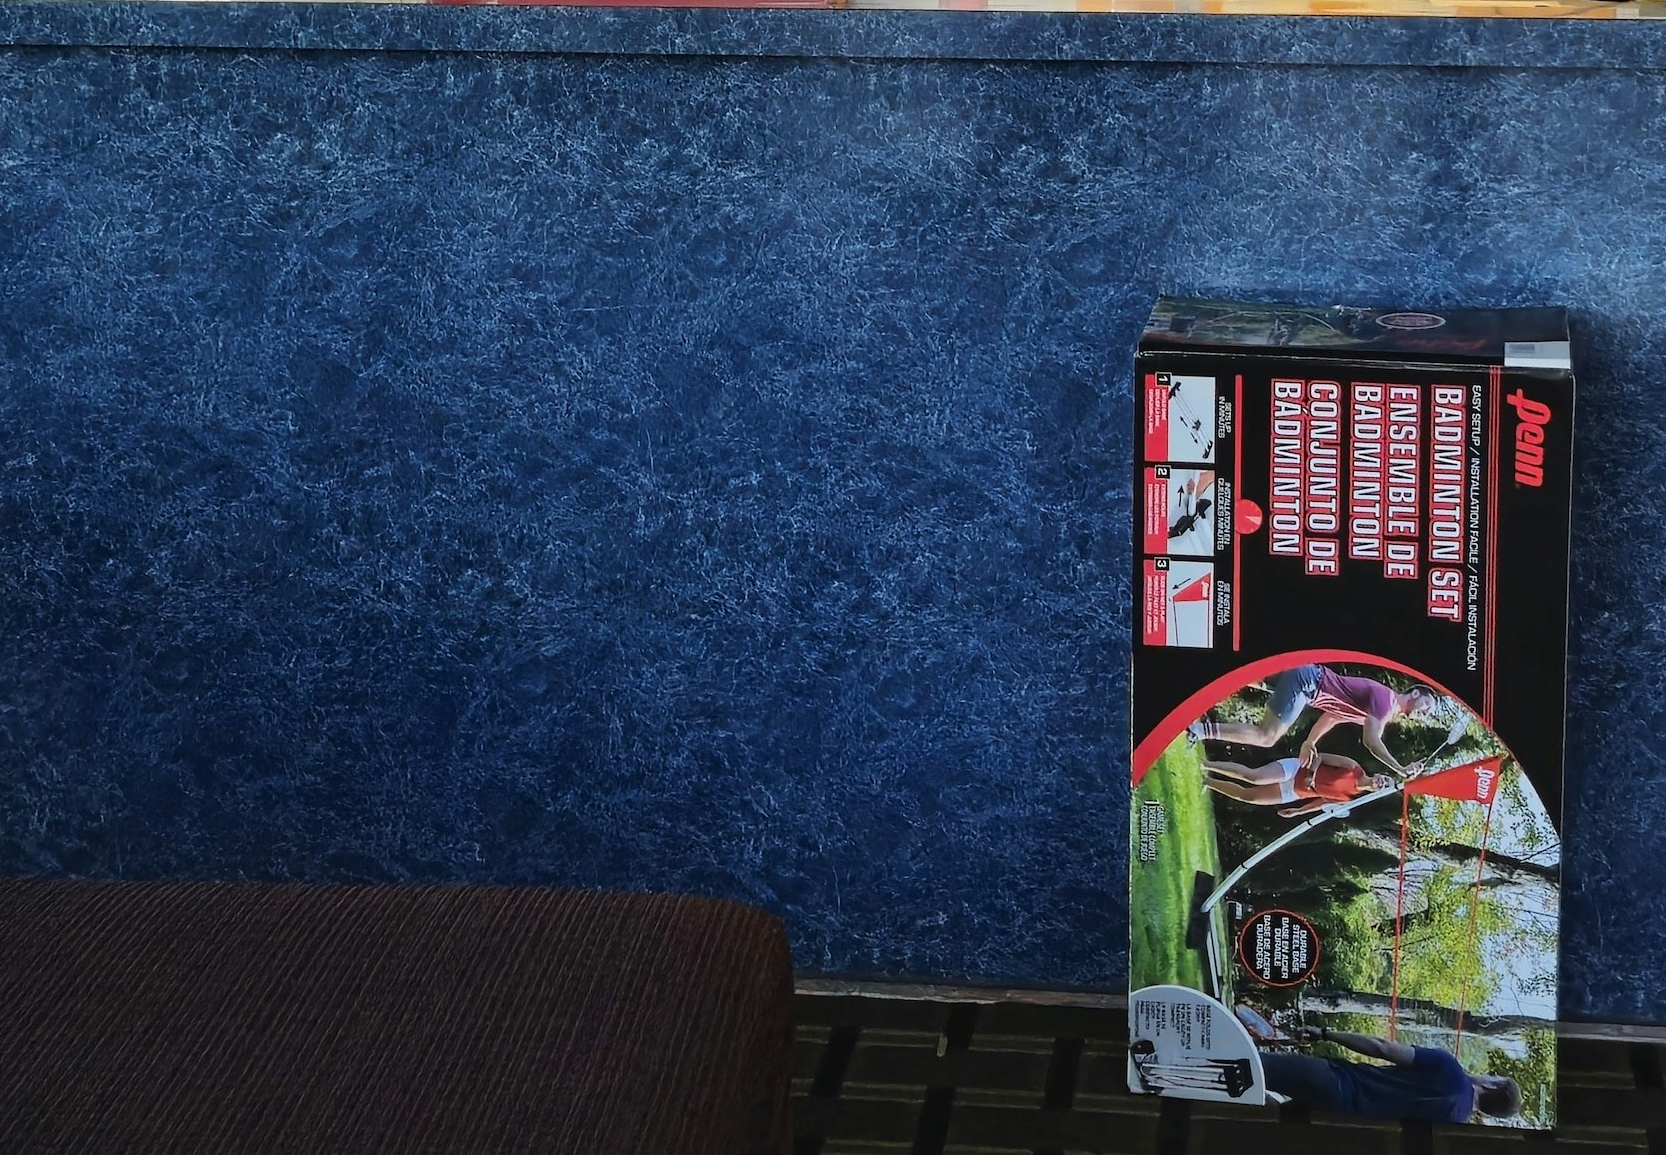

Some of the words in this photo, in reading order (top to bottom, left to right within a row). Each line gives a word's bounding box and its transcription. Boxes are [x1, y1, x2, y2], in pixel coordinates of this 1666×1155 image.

[1158, 375, 1168, 383] 1
[1224, 402, 1232, 421] SETS
[1471, 384, 1482, 412] EASY
[1224, 421, 1231, 433] UP
[1471, 413, 1481, 446] SETUP
[1506, 388, 1551, 489] penn
[1158, 467, 1168, 476] 2
[1271, 380, 1307, 554] BÁDMINTON
[1307, 382, 1340, 531] CONJUNTO
[1351, 384, 1383, 558] BADMINTON
[1386, 385, 1419, 535] ENSEMBLE
[1431, 385, 1464, 561] BADMINTON
[1223, 482, 1231, 535] INSTALLATION
[1469, 457, 1480, 528] INSTALLATION
[1216, 521, 1224, 551] MINUTES
[1468, 529, 1479, 564] FACILE
[1157, 559, 1166, 568] 3
[1307, 540, 1337, 573] DE
[1385, 543, 1416, 577] DE
[1429, 569, 1460, 621] SET
[1467, 574, 1480, 603] FÁCIL
[1216, 591, 1224, 626] MINUTOS
[1466, 605, 1479, 671] INSTALACIÓN
[1474, 766, 1495, 799] penn
[1263, 914, 1271, 937] BASE
[1281, 916, 1289, 939] BASE
[1292, 924, 1300, 950] STEEL
[1256, 923, 1264, 970] DURADERA
[1263, 938, 1271, 950] DE
[1274, 928, 1282, 967] DURABLE
[1281, 940, 1289, 953] EN
[1299, 929, 1307, 969] DURABLE
[1262, 950, 1271, 980] ACERO
[1281, 953, 1289, 979] ACIER
[1292, 950, 1300, 973] BASE
